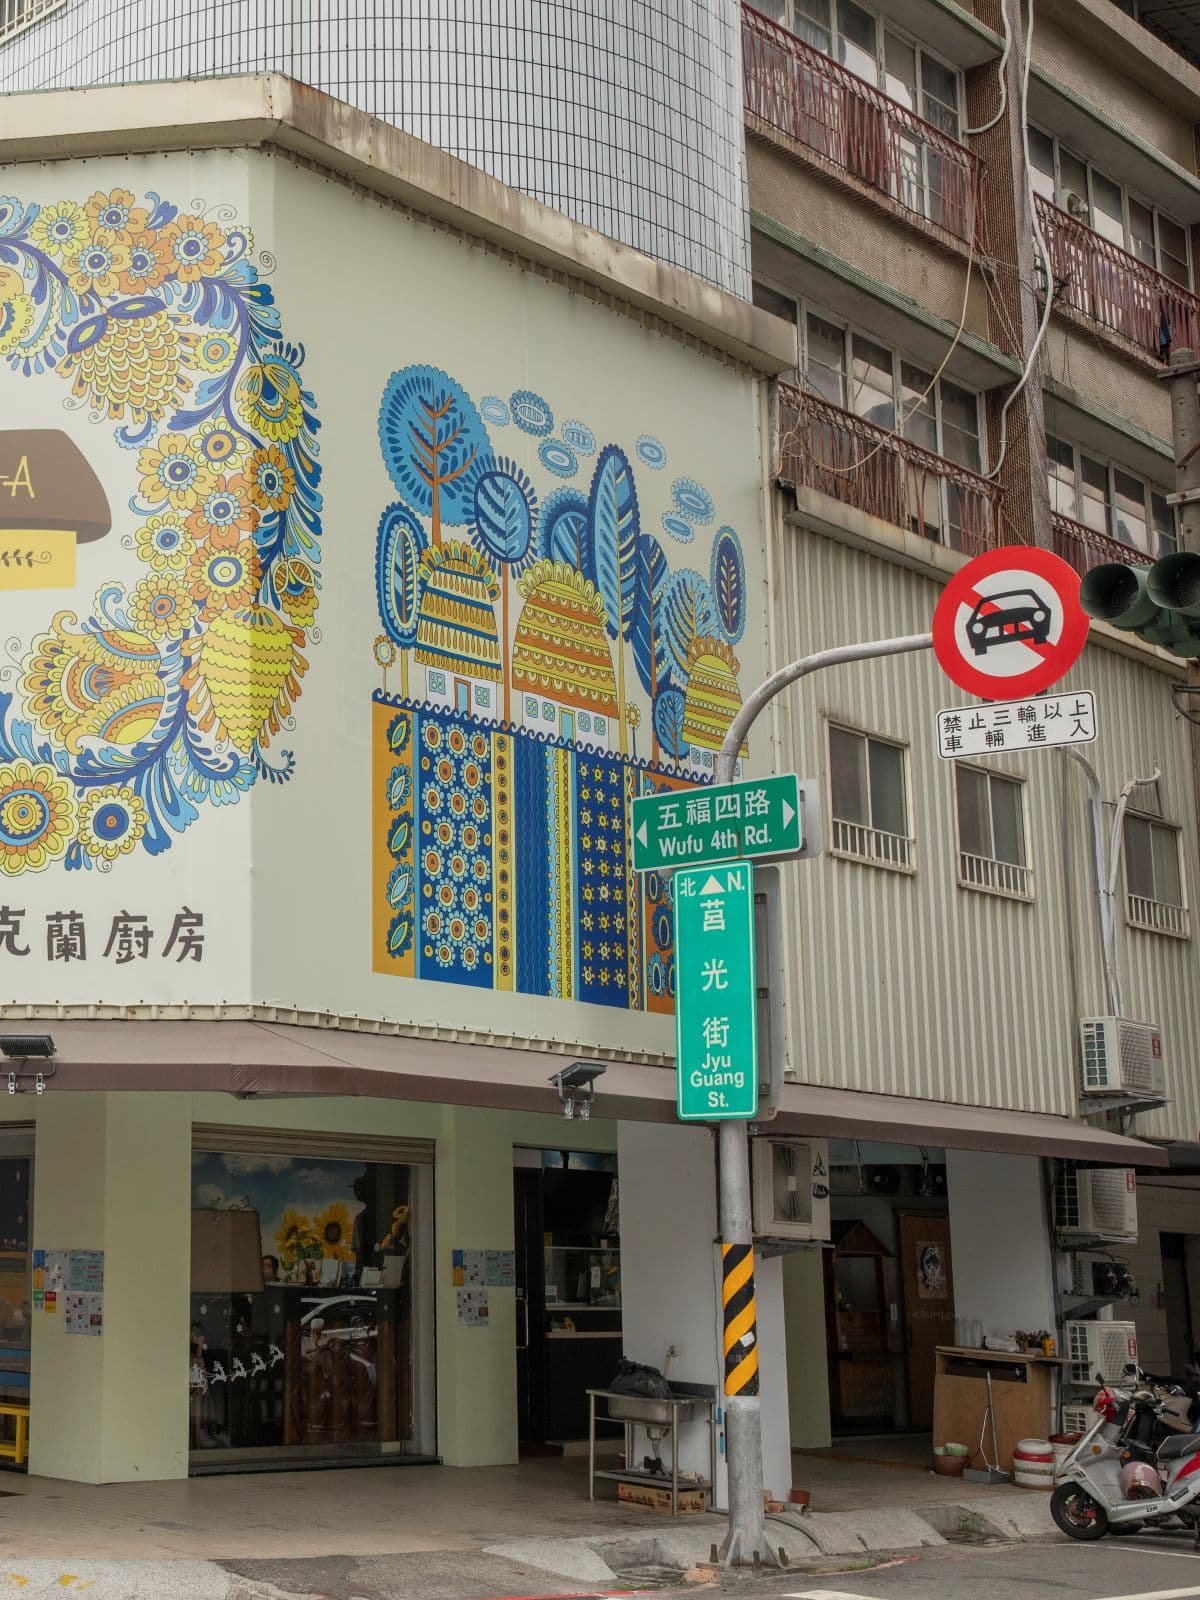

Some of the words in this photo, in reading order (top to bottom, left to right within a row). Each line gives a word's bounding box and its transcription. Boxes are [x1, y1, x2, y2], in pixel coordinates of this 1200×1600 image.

[943, 699, 1089, 734] 禁止三輪以上
[944, 719, 1090, 753] 車輛進入
[657, 788, 771, 831] 五福四路
[658, 834, 704, 858] Wufu
[710, 828, 738, 850] 4th
[744, 823, 773, 846] Rd.
[680, 877, 697, 898] 北
[727, 870, 746, 892] N.
[700, 898, 730, 1049] 莒光街
[701, 1052, 731, 1073] Jyu
[690, 1070, 745, 1089] Guang
[707, 1091, 730, 1108] St.
